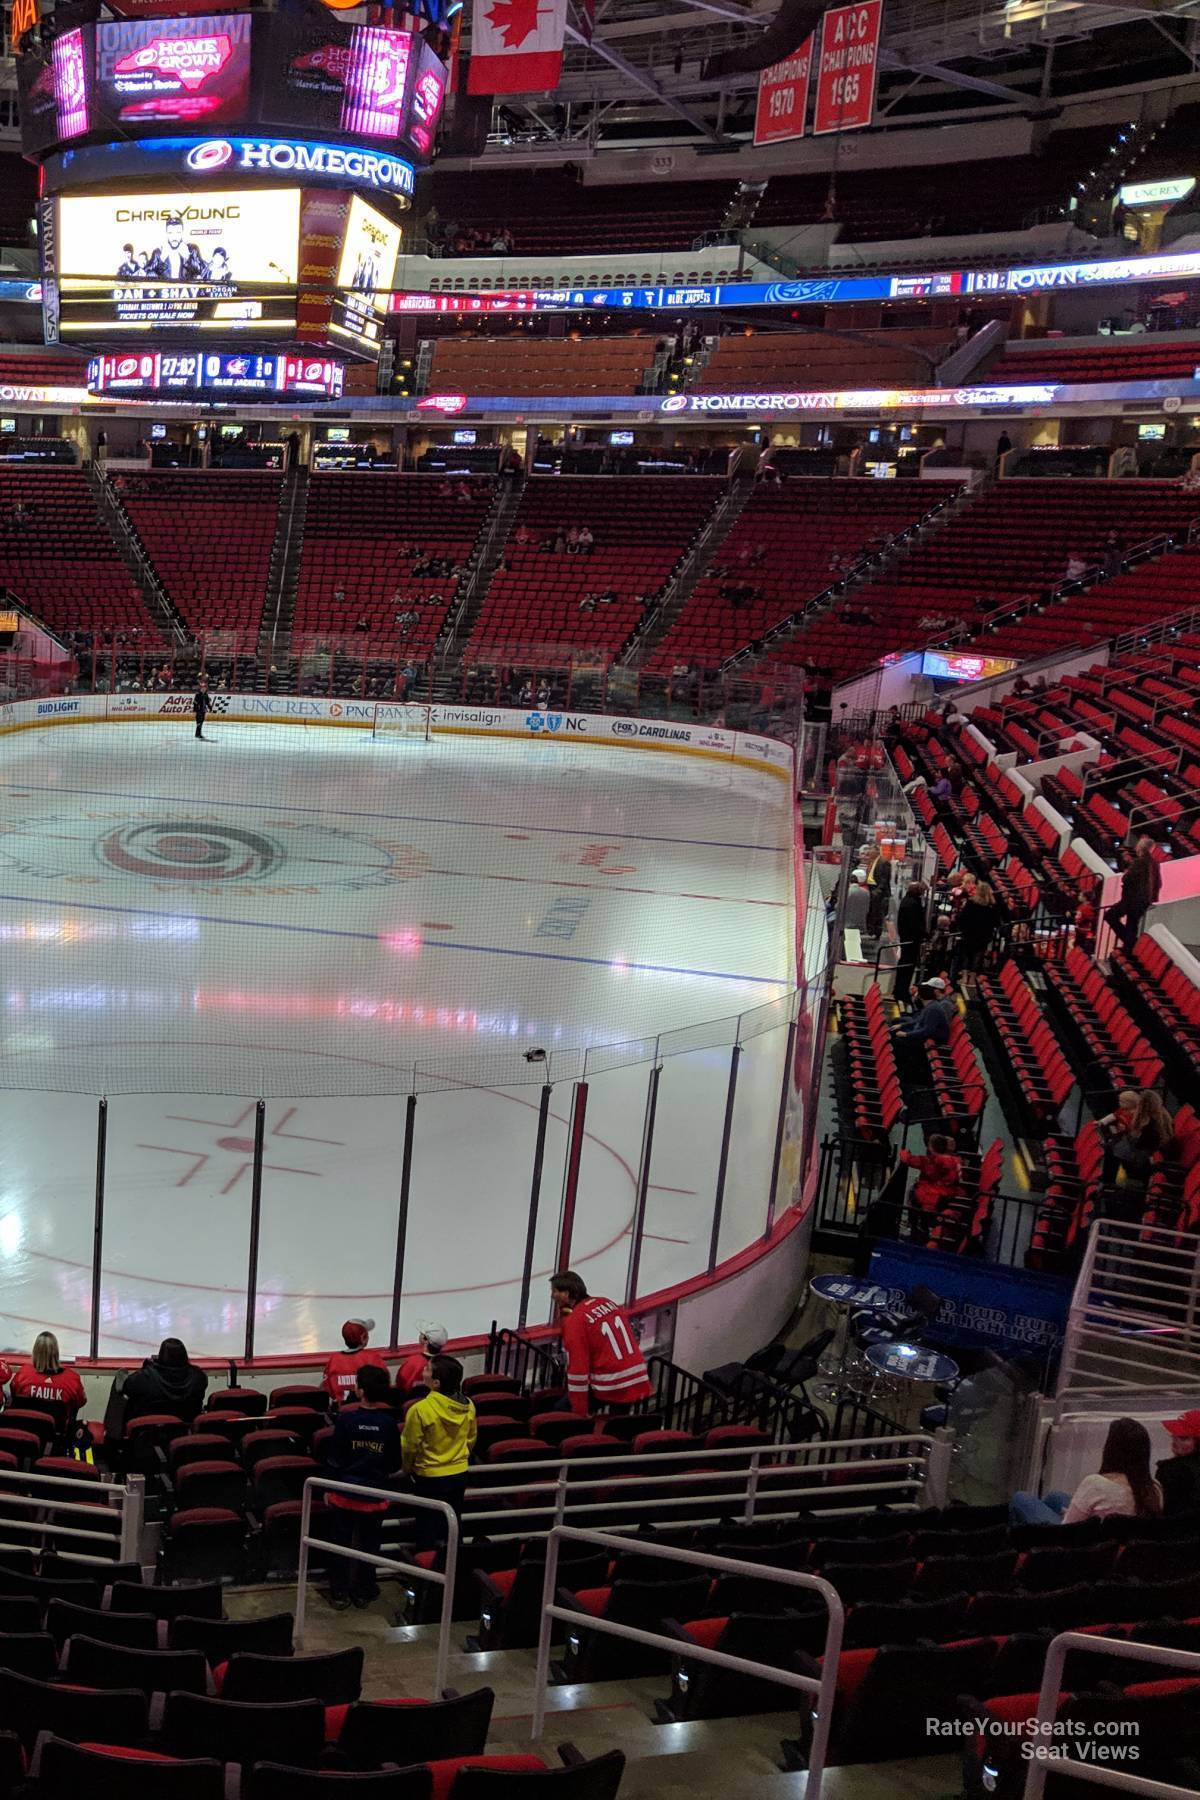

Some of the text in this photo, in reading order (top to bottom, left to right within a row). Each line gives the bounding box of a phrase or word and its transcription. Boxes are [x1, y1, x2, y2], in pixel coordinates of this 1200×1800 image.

[834, 9, 868, 43] ACC
[158, 39, 218, 56] HOME
[158, 53, 222, 69] GROWN
[823, 41, 875, 73] CHAMPIONS
[769, 87, 795, 118] 1970
[240, 142, 416, 189] HOMEGROWN
[1160, 184, 1180, 196] REX
[116, 205, 240, 223] CHRIS YOUNG
[113, 288, 144, 300] DAN
[160, 287, 199, 299] SHAY
[119, 312, 147, 320] TICKETS
[177, 311, 195, 319] NOW
[141, 356, 152, 377] 0
[206, 356, 220, 377] 0
[691, 394, 838, 411] HOMEGROWN
[37, 701, 79, 714] BUD LIGHT
[158, 704, 181, 714] Auto
[242, 700, 322, 716] UNC REX
[443, 709, 501, 723] invisalign
[566, 717, 588, 732] NC
[617, 723, 691, 742] FOX CAROLINAS
[601, 1315, 635, 1361] 11
[30, 1385, 63, 1401] FAULK
